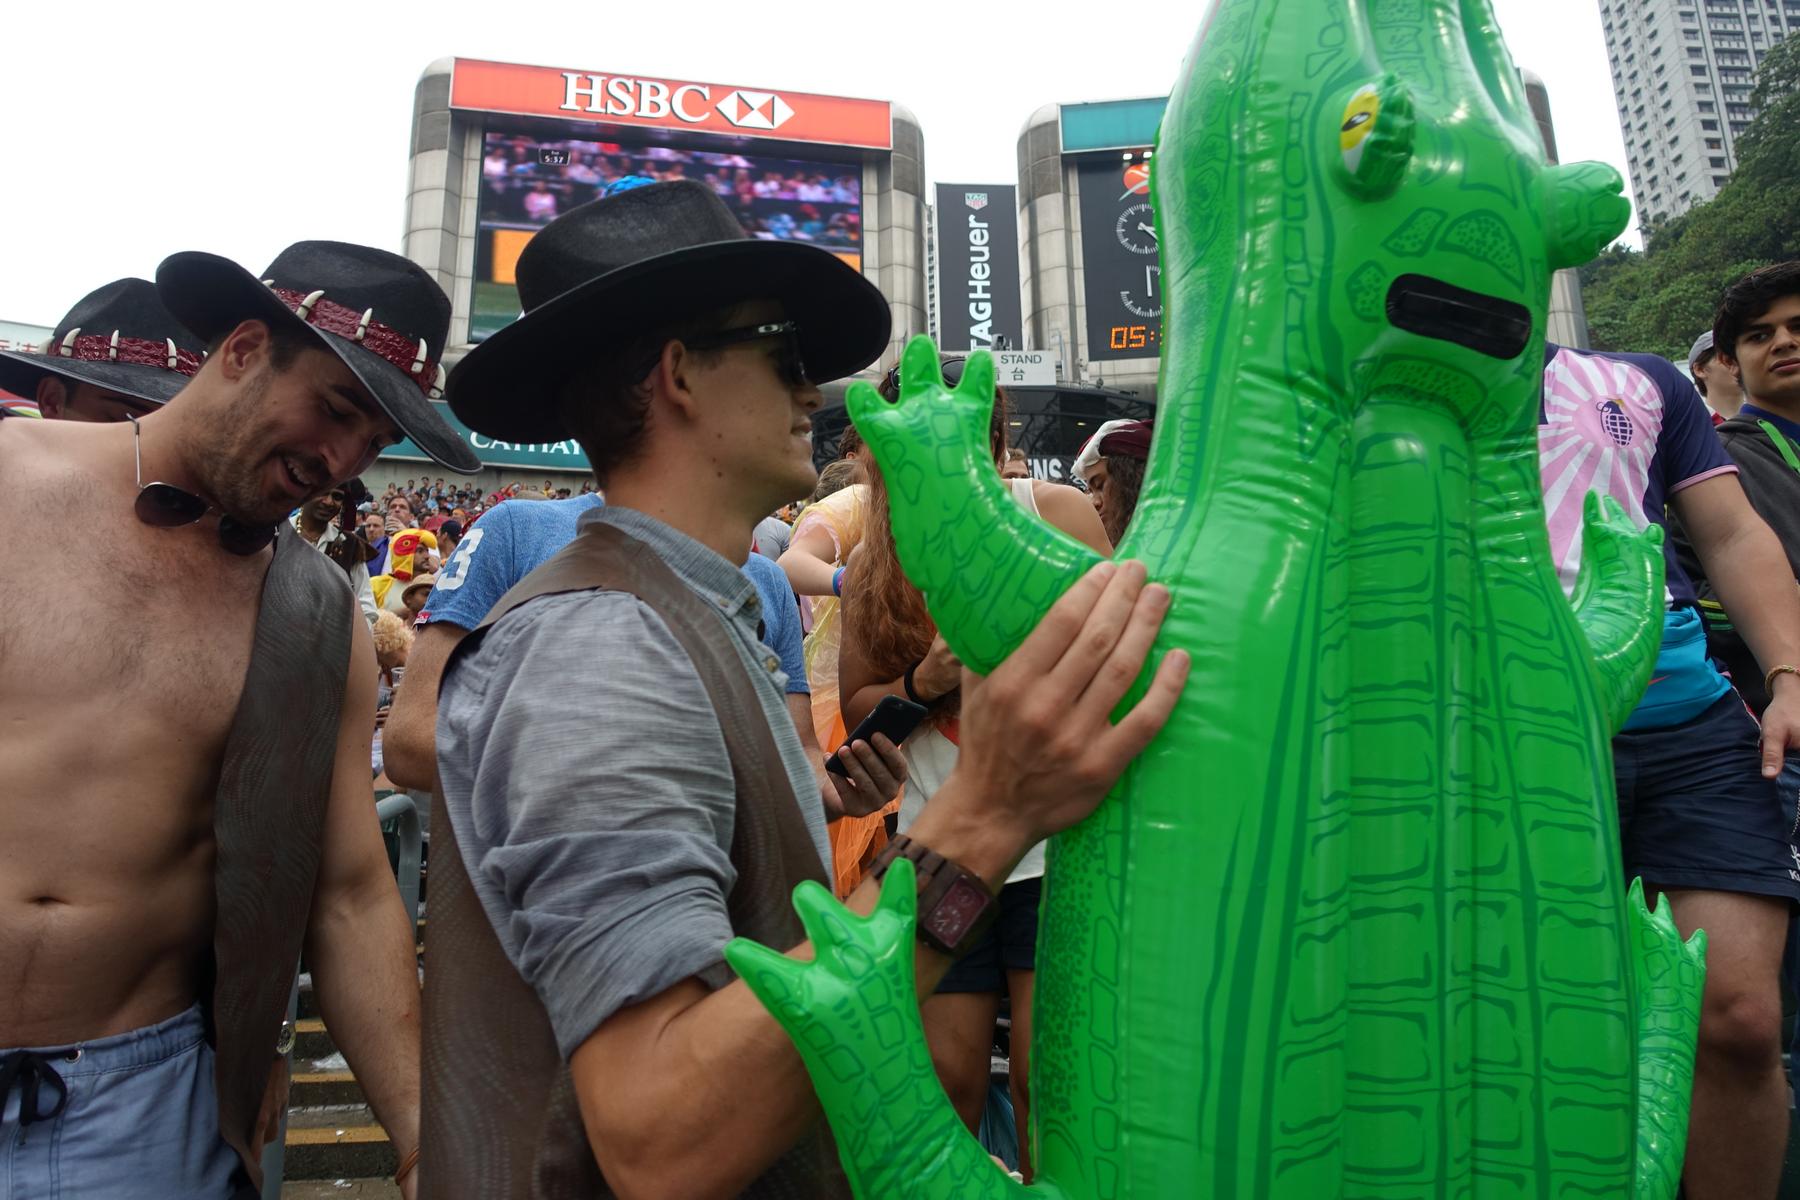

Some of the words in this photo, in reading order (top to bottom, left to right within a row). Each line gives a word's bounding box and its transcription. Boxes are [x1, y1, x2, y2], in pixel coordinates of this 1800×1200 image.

[559, 72, 711, 123] HSBC
[1000, 354, 1042, 364] STAND
[436, 528, 484, 591] 3
